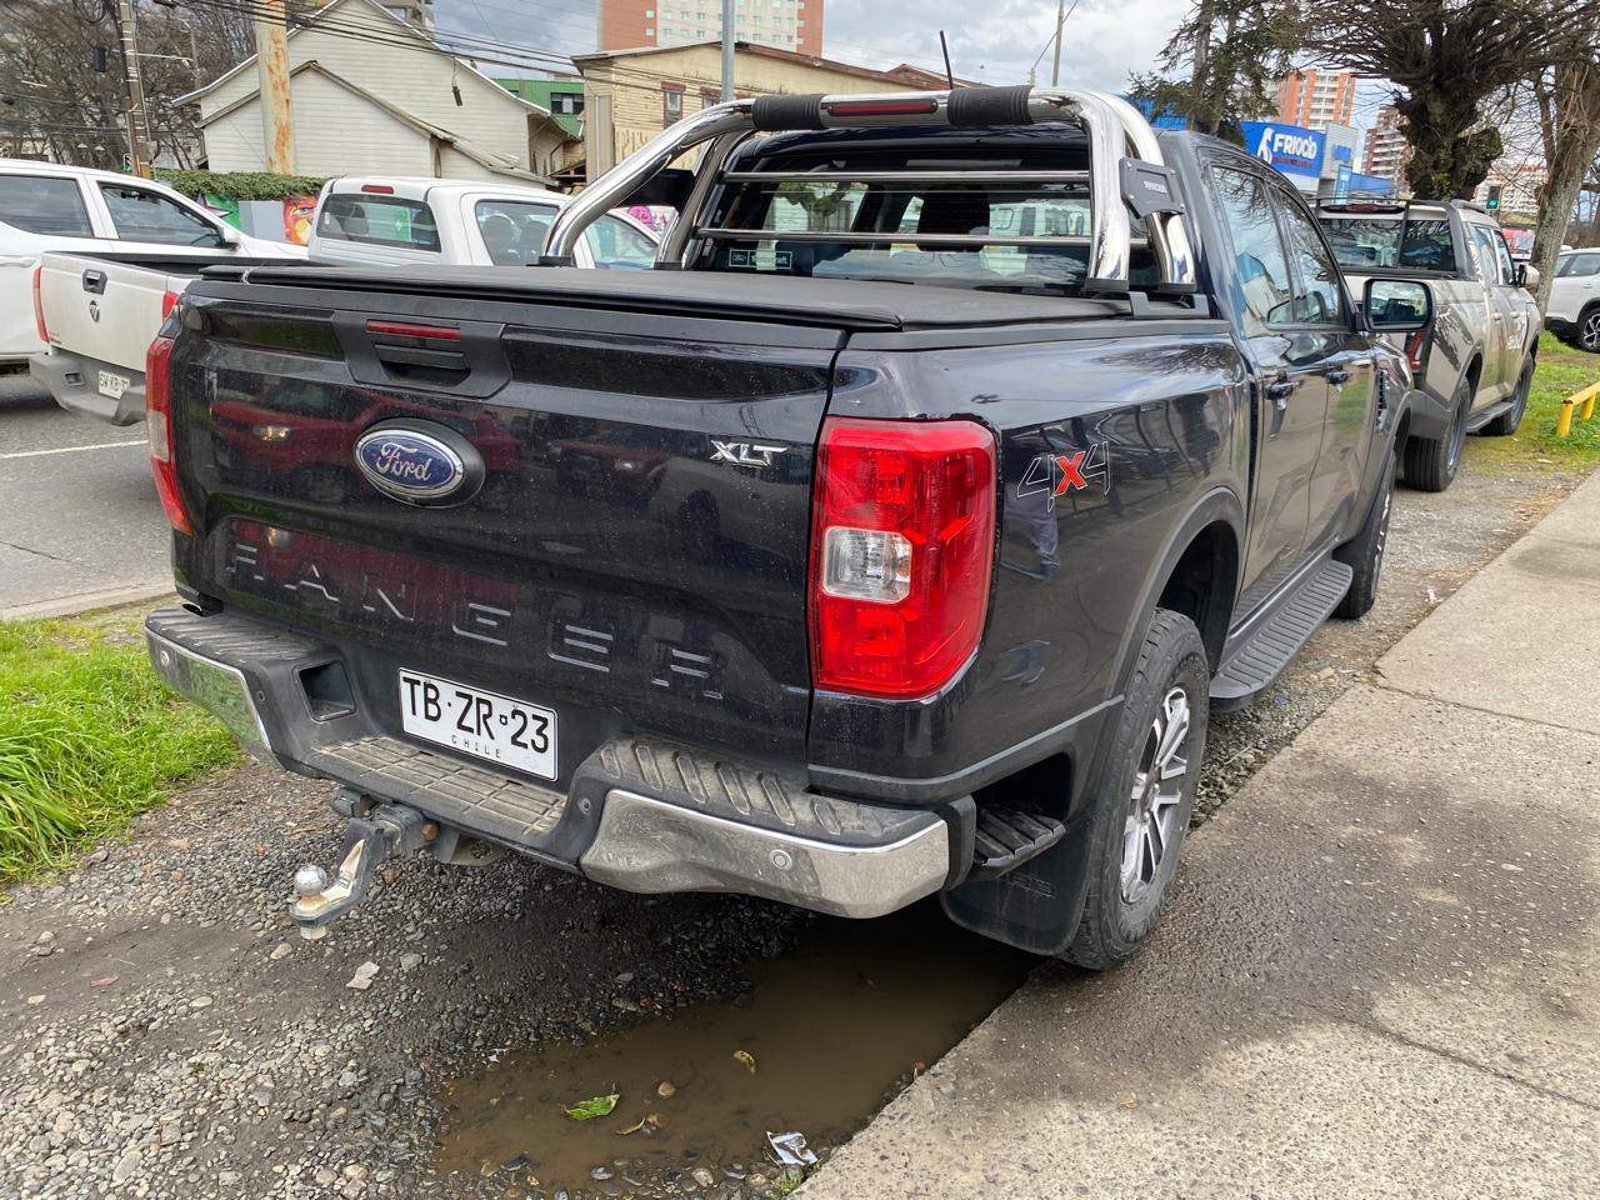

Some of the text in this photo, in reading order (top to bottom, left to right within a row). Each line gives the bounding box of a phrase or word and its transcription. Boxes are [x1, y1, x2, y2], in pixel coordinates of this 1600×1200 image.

[375, 441, 432, 481] Ford
[709, 439, 788, 467] XLT
[225, 540, 724, 701] RANGER
[451, 734, 501, 758] CHILE
